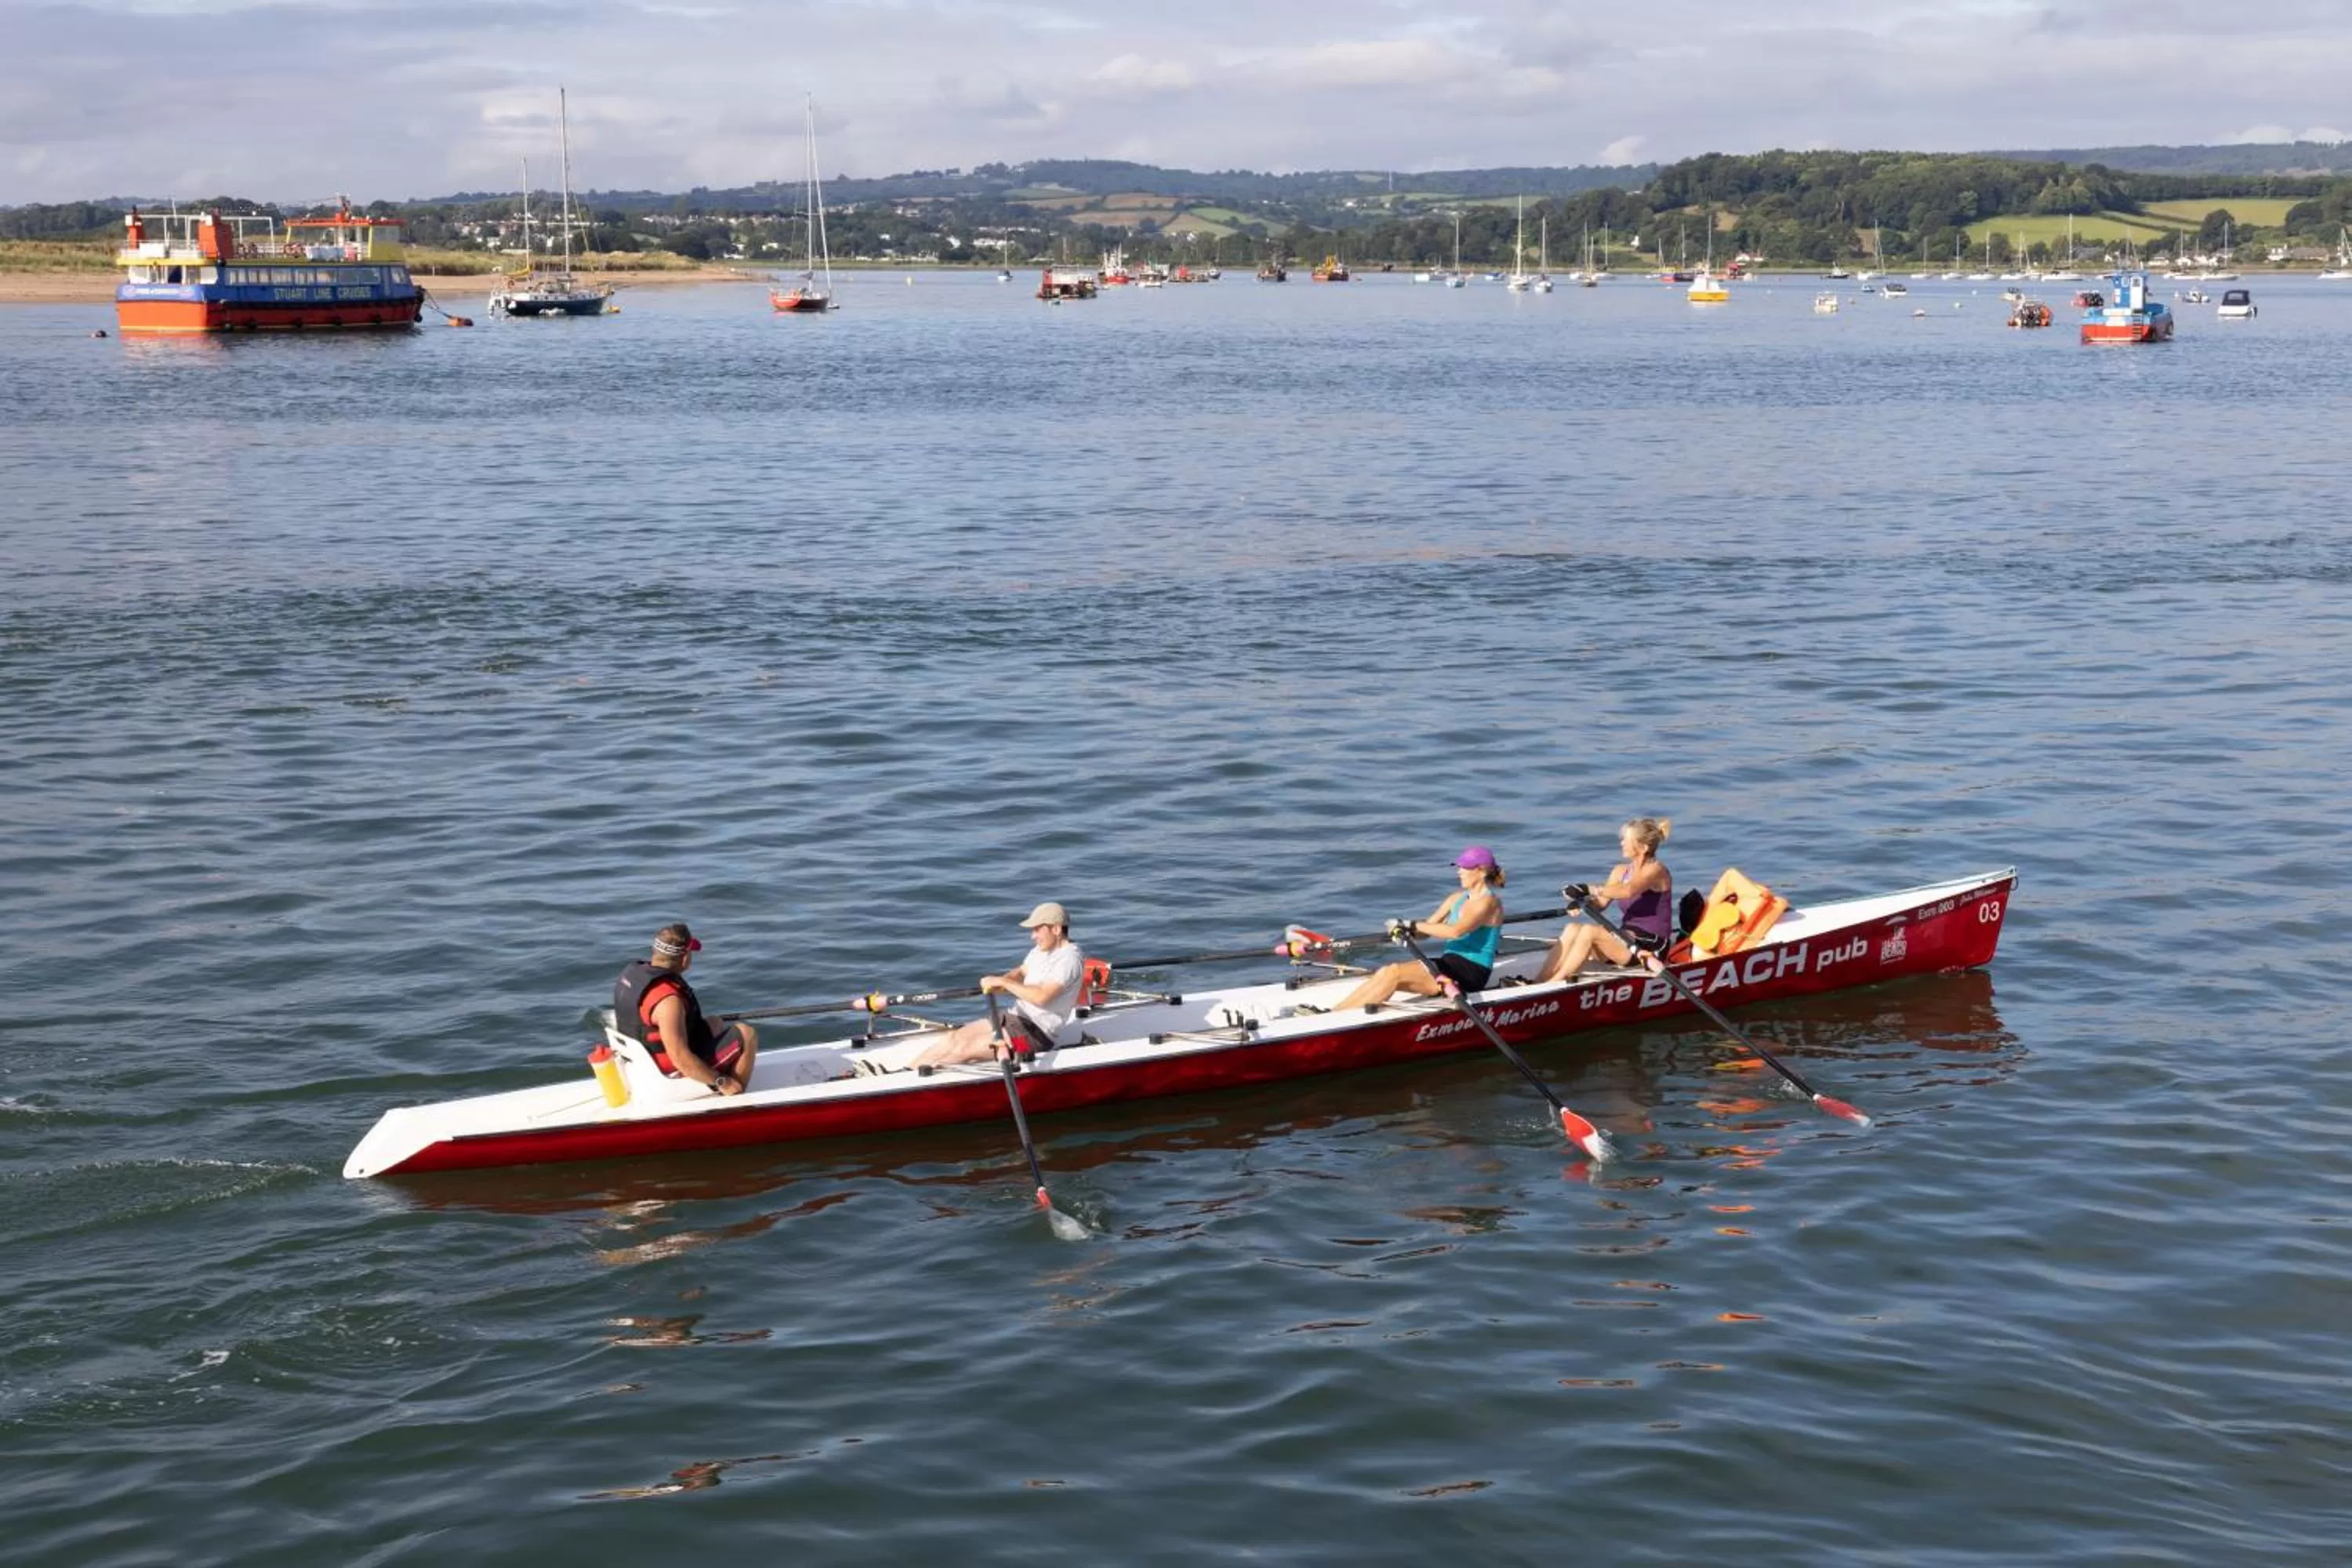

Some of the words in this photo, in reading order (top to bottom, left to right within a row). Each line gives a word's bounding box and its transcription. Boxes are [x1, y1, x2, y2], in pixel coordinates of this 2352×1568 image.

[1979, 901, 2000, 923] 03
[1580, 983, 1632, 1010] the
[1639, 942, 1807, 1009] BEACH
[1816, 937, 1867, 972] pub
[1494, 1000, 1560, 1028] Marina
